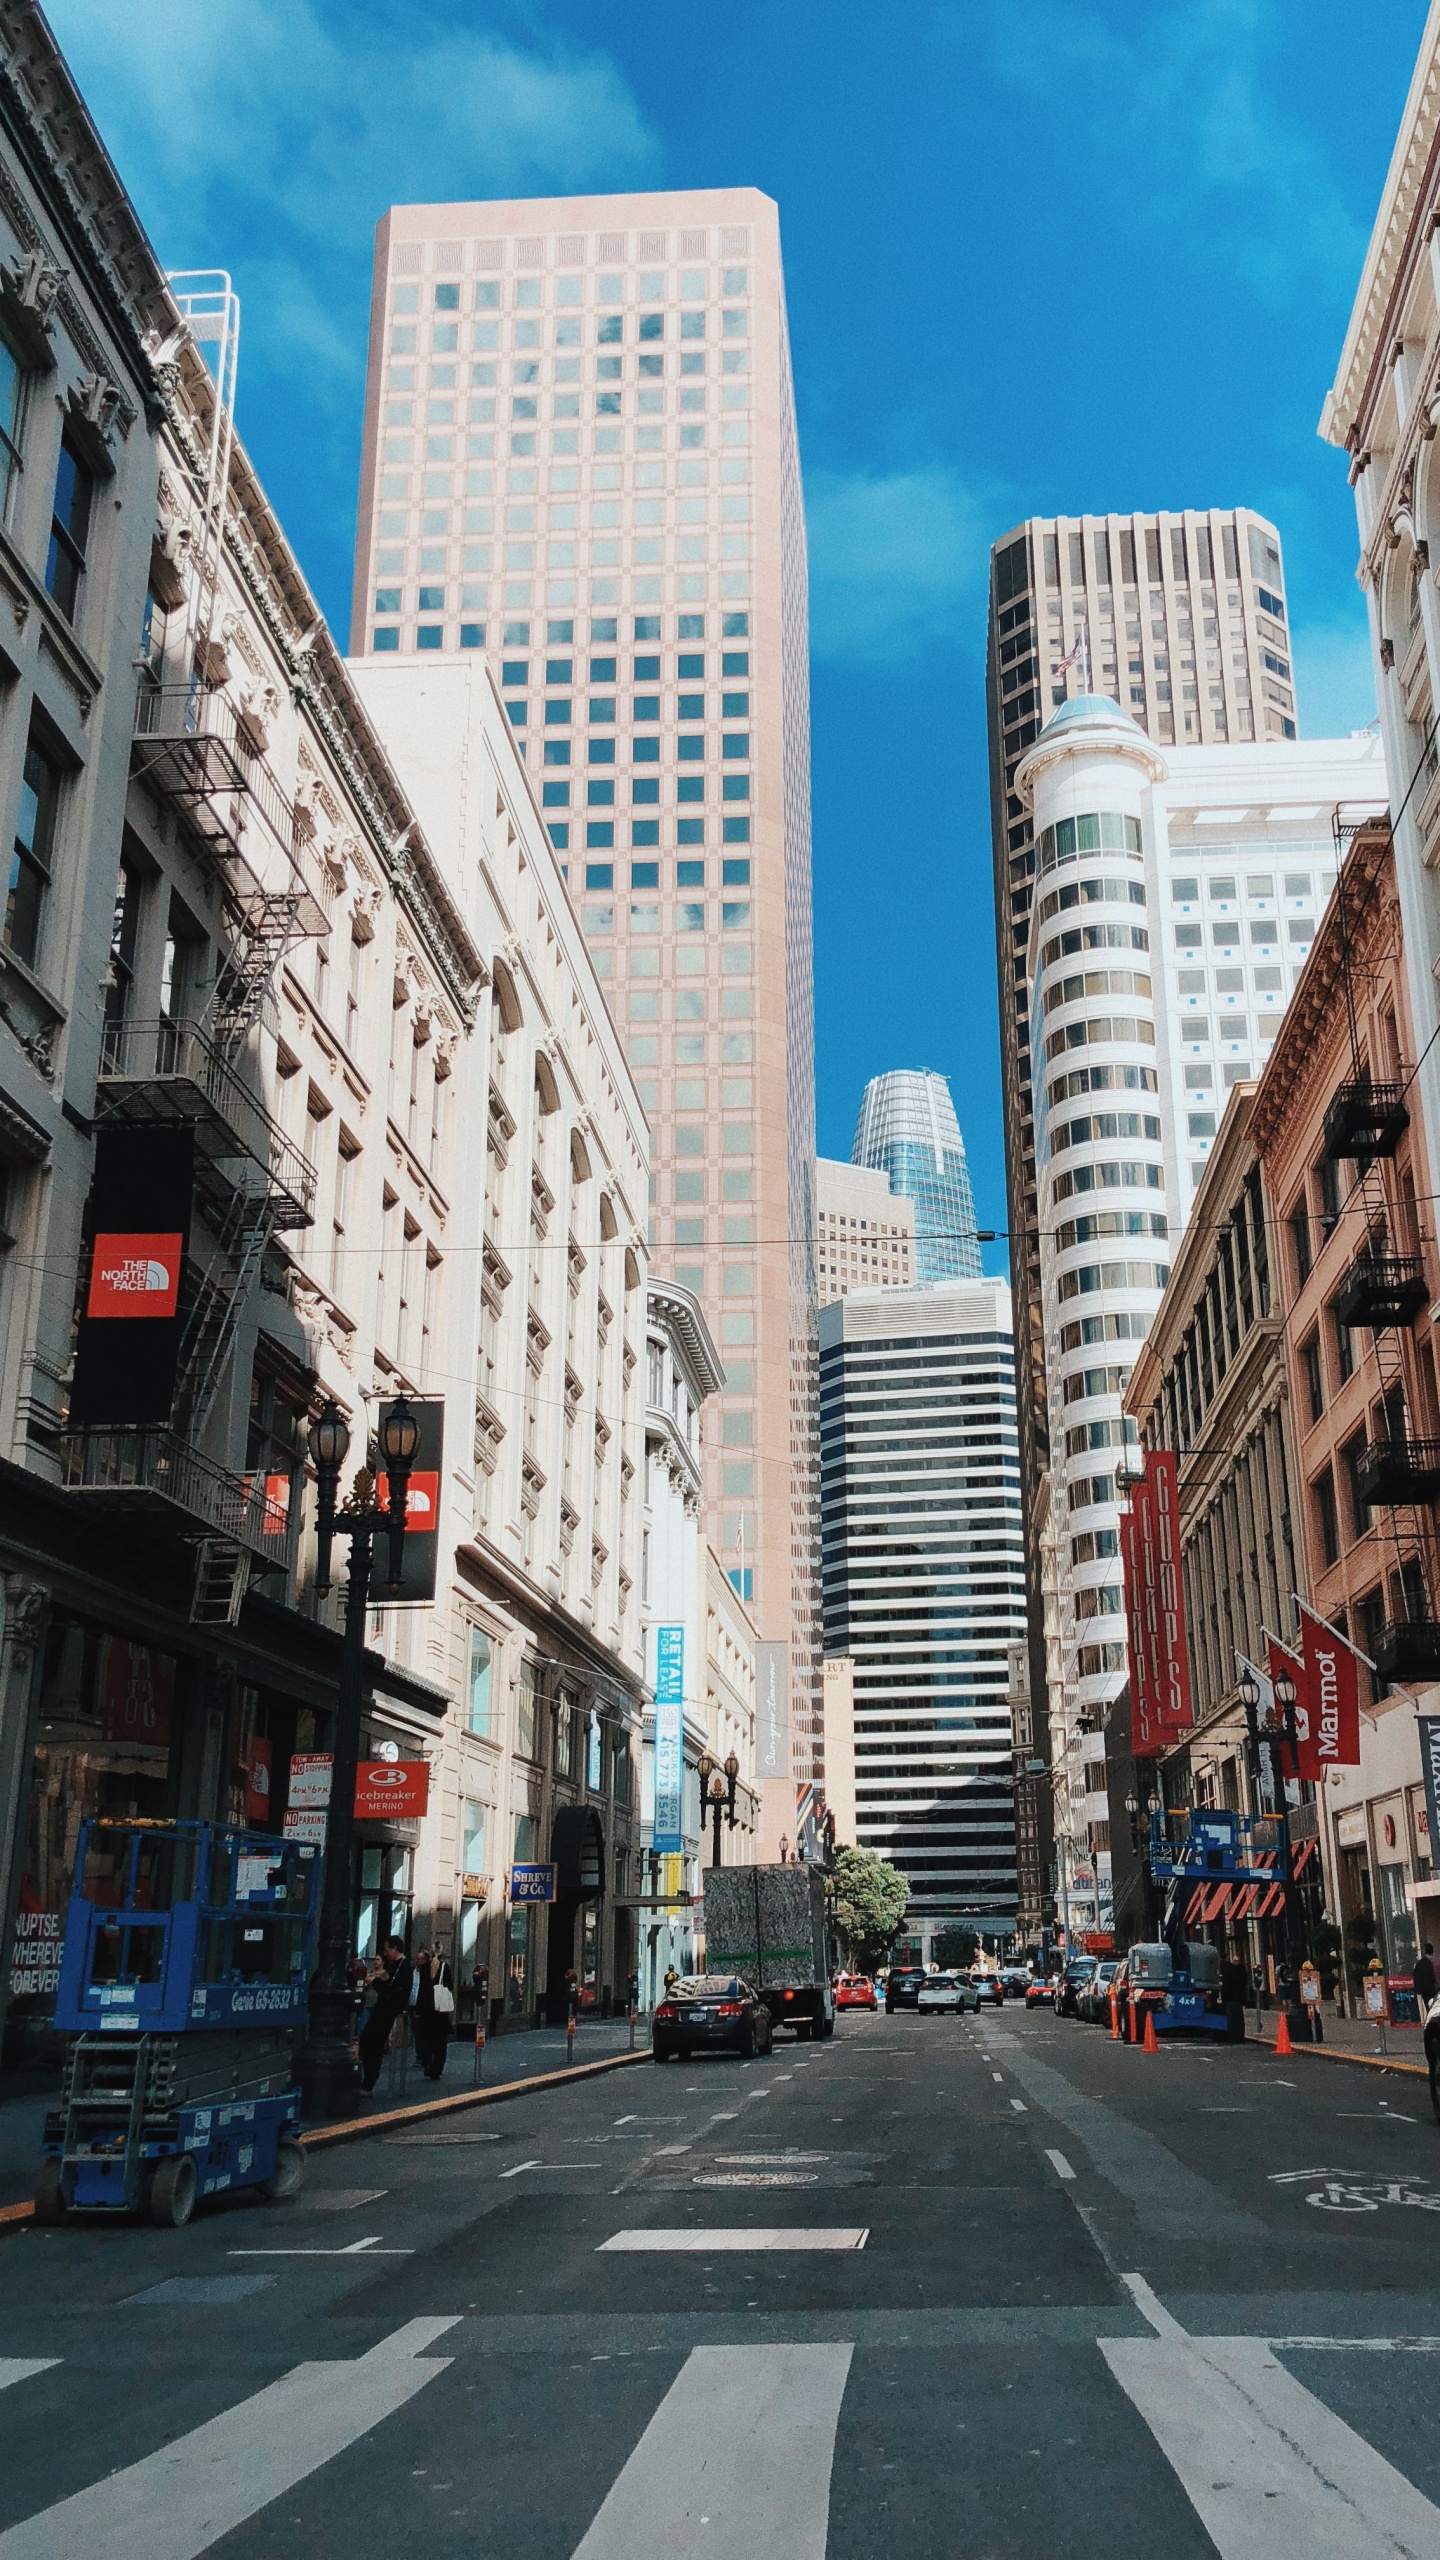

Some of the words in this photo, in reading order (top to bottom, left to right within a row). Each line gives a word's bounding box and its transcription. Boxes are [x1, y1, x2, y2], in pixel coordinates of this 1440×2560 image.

[122, 1260, 147, 1271] THE
[101, 1270, 146, 1281] NORTH
[113, 1280, 146, 1291] FACE
[660, 1630, 669, 1655] FOR
[668, 1630, 681, 1694] RETAIL
[659, 1660, 669, 1699] LEASE
[1315, 1650, 1339, 1758] Marmot
[291, 1763, 304, 1774] NO
[305, 1763, 332, 1772] STOPPING
[356, 1790, 417, 1800] icebreaker
[368, 1802, 404, 1811] MERINO
[669, 1781, 678, 1829] MORGAN
[285, 1813, 298, 1825] NO
[299, 1815, 326, 1825] PARKING
[231, 1991, 254, 2012] Genie
[1179, 1997, 1196, 2005] 4x4
